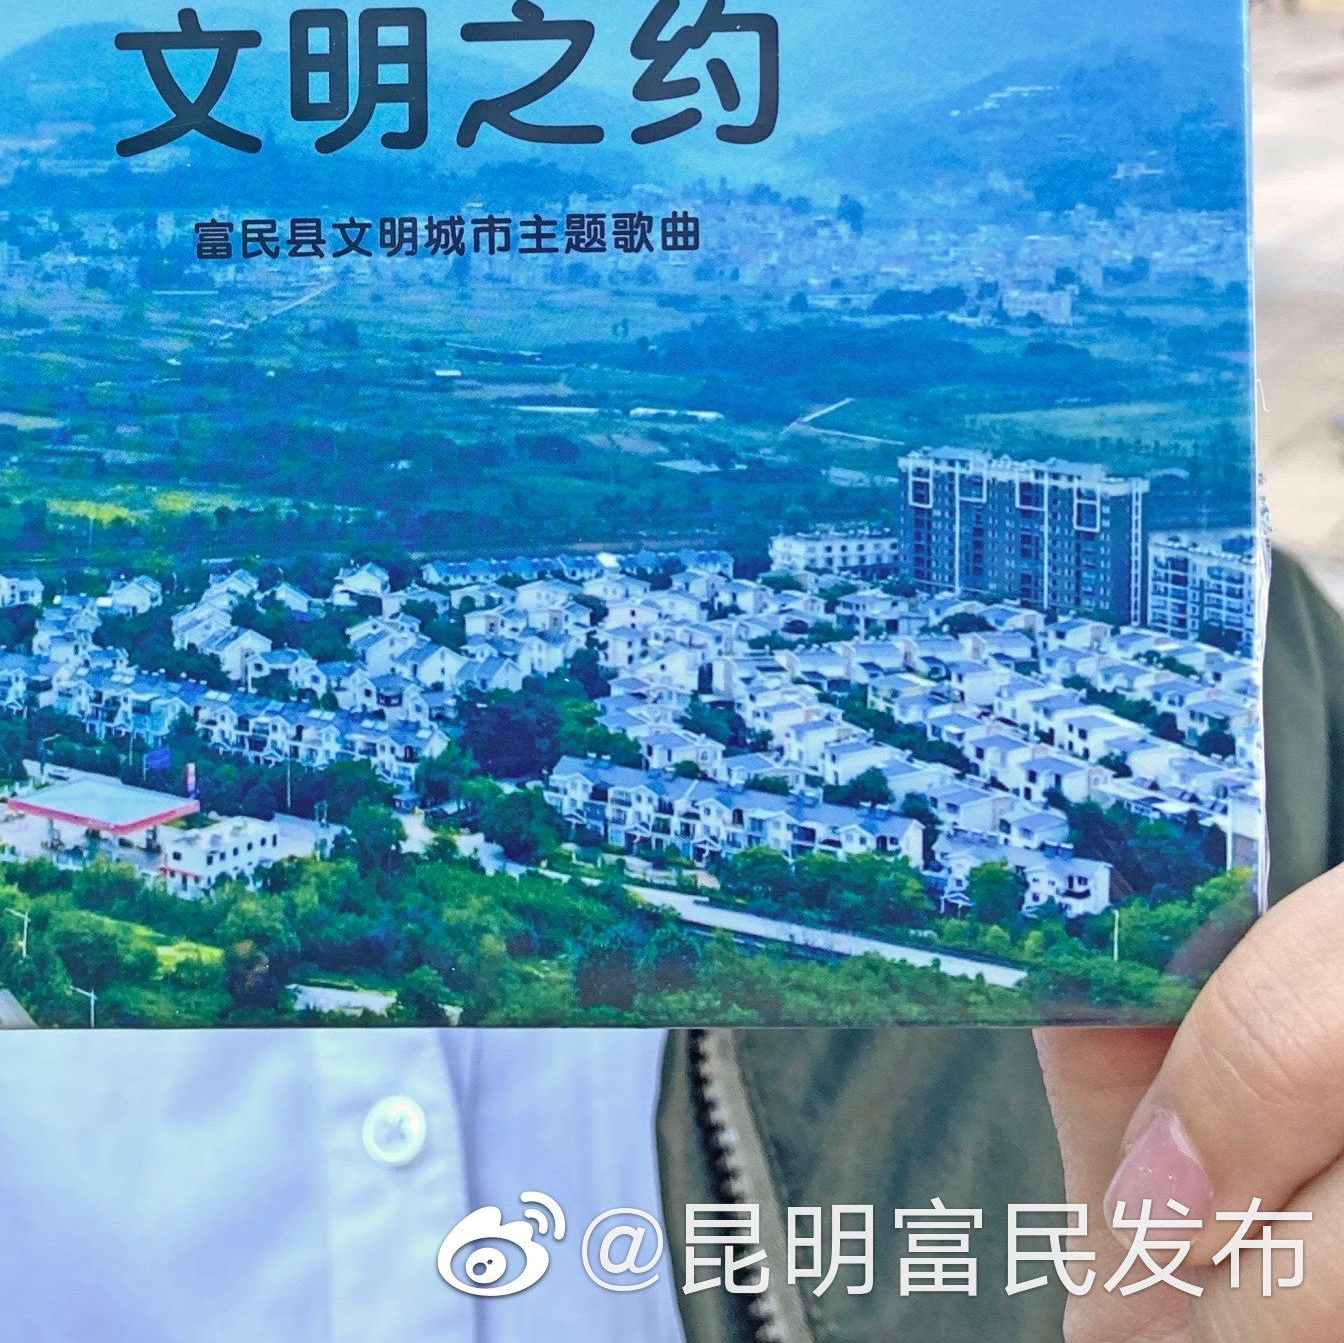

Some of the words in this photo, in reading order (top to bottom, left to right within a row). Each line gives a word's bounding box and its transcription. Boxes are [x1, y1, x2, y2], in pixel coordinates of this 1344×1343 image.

[194, 210, 701, 260] 富民县文明城市主题歌曲
